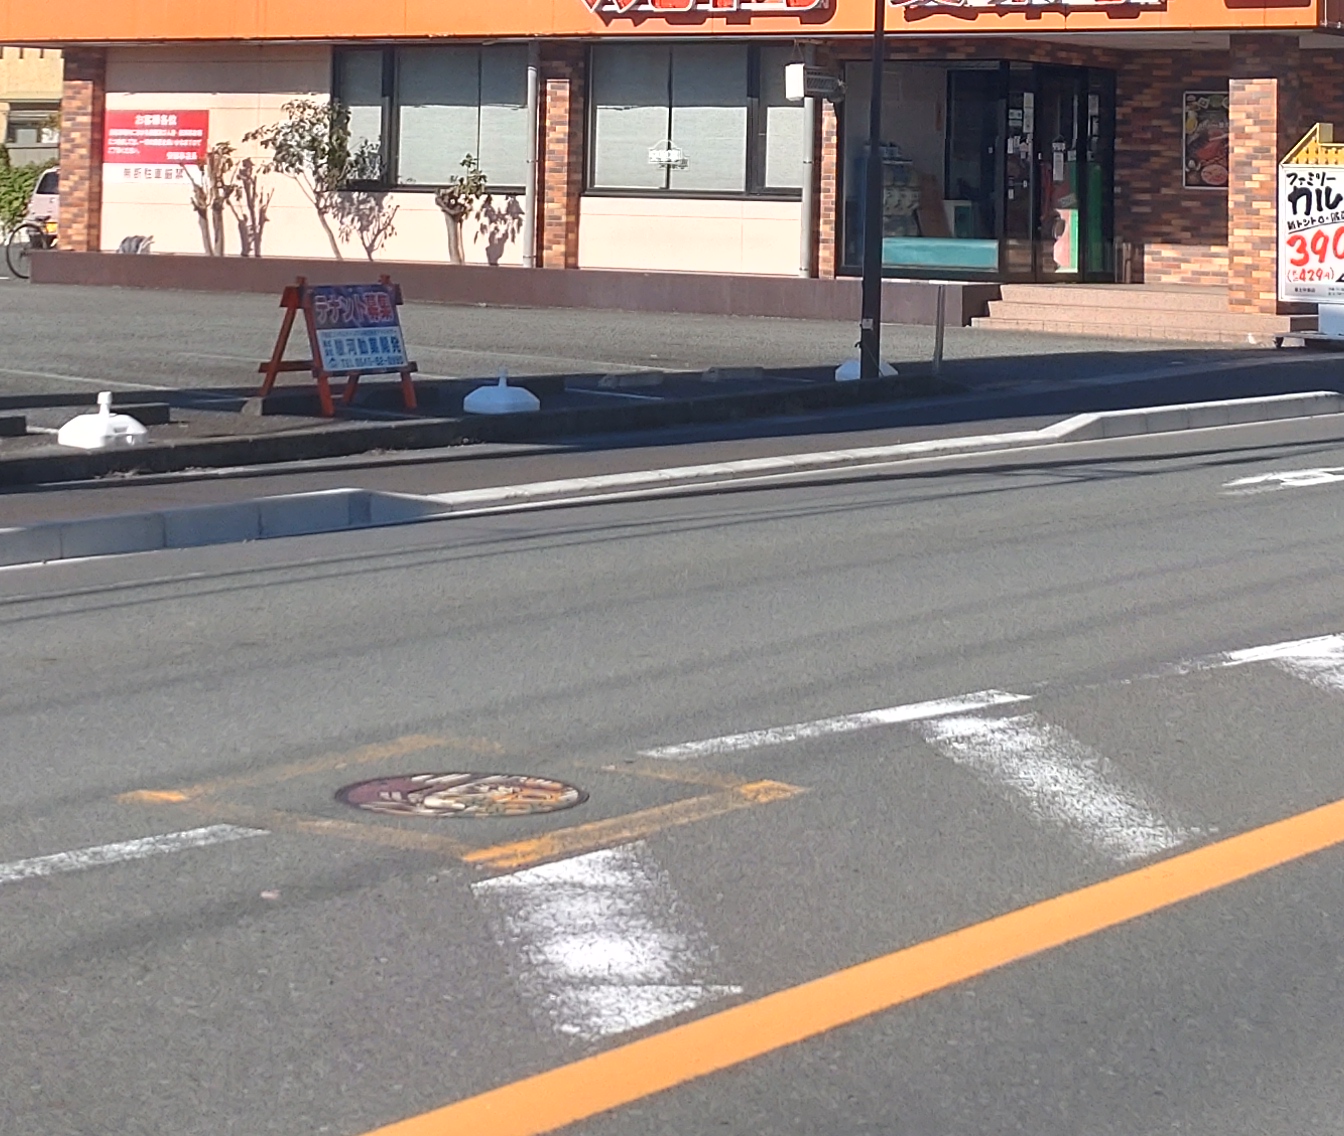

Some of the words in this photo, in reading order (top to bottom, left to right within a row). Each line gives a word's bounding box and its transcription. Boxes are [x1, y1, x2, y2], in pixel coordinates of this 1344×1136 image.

[1286, 172, 1336, 186] ファミリー
